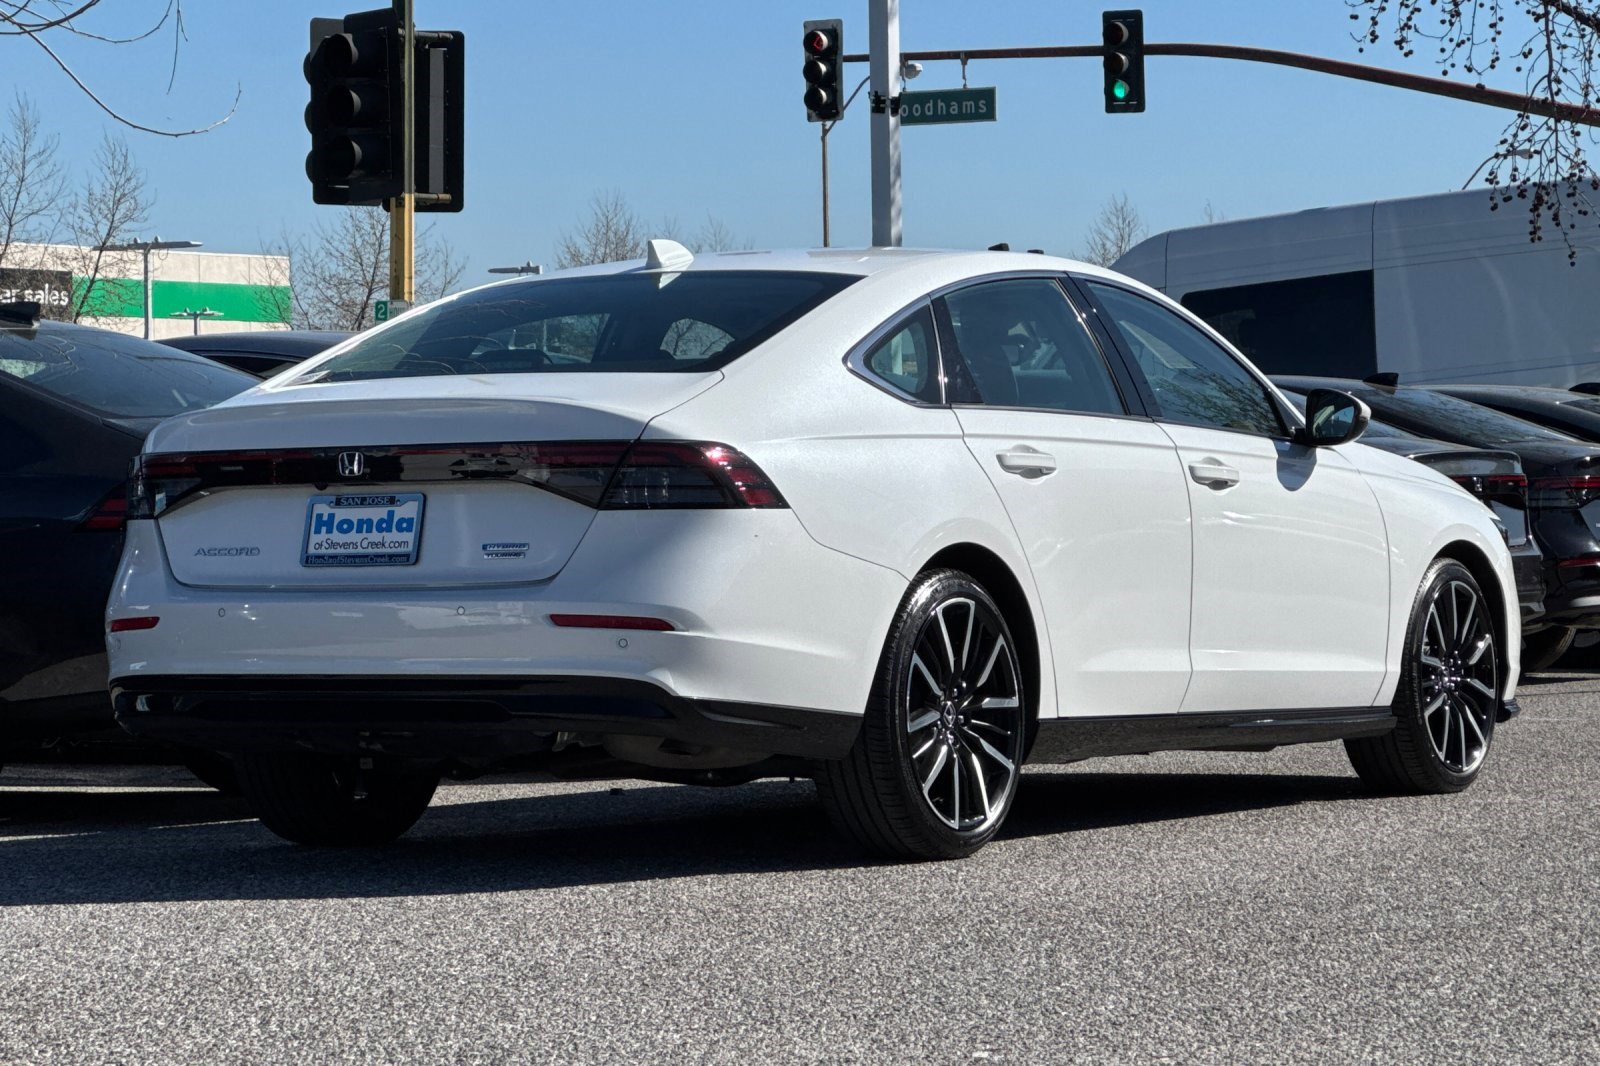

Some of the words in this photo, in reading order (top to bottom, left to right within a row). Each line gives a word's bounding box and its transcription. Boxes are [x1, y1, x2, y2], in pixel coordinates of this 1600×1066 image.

[900, 99, 987, 117] oodhams
[0, 289, 20, 303] ar
[24, 283, 69, 306] sales
[377, 303, 386, 319] 2
[340, 497, 361, 506] SAN
[363, 496, 390, 505] JOSE
[313, 509, 415, 534] Honda
[313, 540, 324, 550] of
[324, 538, 359, 550] Stevens
[360, 536, 409, 550] Creek.com
[193, 547, 261, 557] ACCORD
